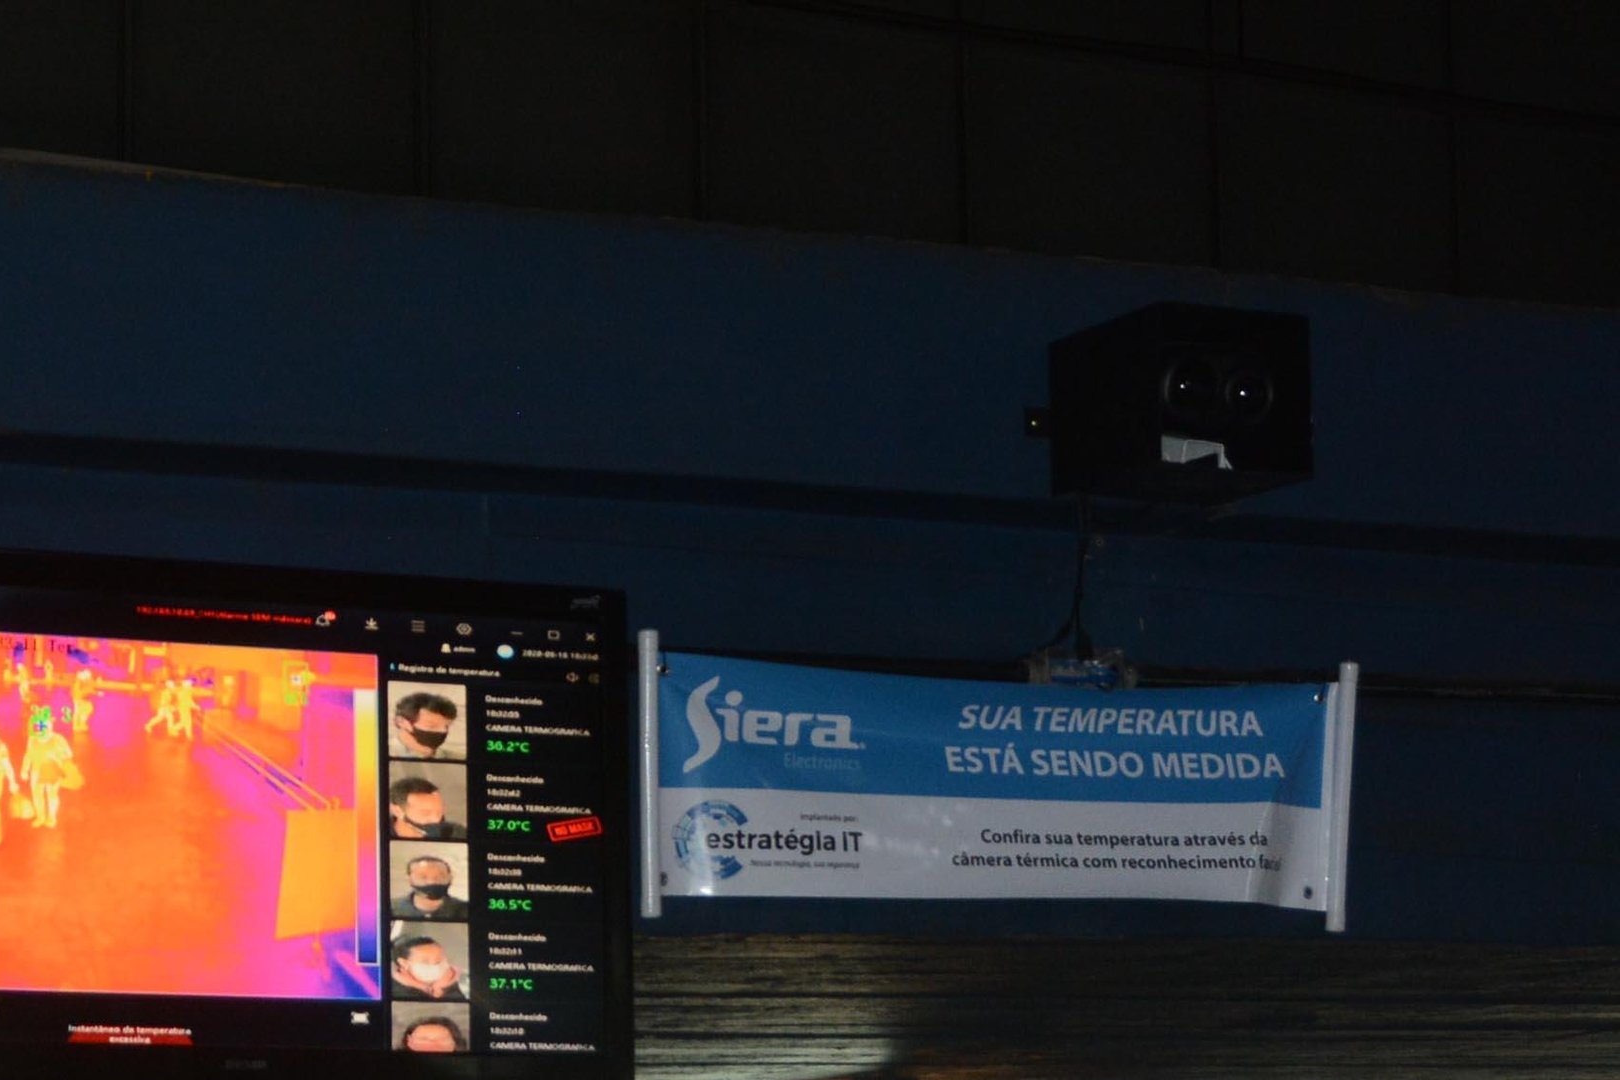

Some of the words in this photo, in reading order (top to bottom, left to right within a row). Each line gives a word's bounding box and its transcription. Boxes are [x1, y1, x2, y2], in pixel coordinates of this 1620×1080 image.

[683, 675, 861, 774] Siera
[958, 705, 1023, 731] SUA
[1033, 706, 1263, 738] TEMPERATURA
[486, 740, 530, 753] 36.2°C
[944, 742, 1025, 776] ESTÁ
[1031, 749, 1144, 778] SENDO
[1152, 752, 1286, 780] MEDIDA
[487, 819, 531, 832] 37.0°C
[842, 831, 863, 852] IT
[980, 828, 1041, 846] Confira
[1045, 834, 1073, 846] sua
[1076, 833, 1180, 851] temperatura
[1184, 832, 1245, 847] através
[1249, 831, 1268, 846] da
[952, 853, 1013, 869] câmera
[1016, 852, 1079, 869] térmica
[1083, 856, 1118, 869] com
[1121, 854, 1256, 870] reconhecimento
[488, 898, 532, 911] 36.5°C
[489, 978, 533, 990] 37.1°C
